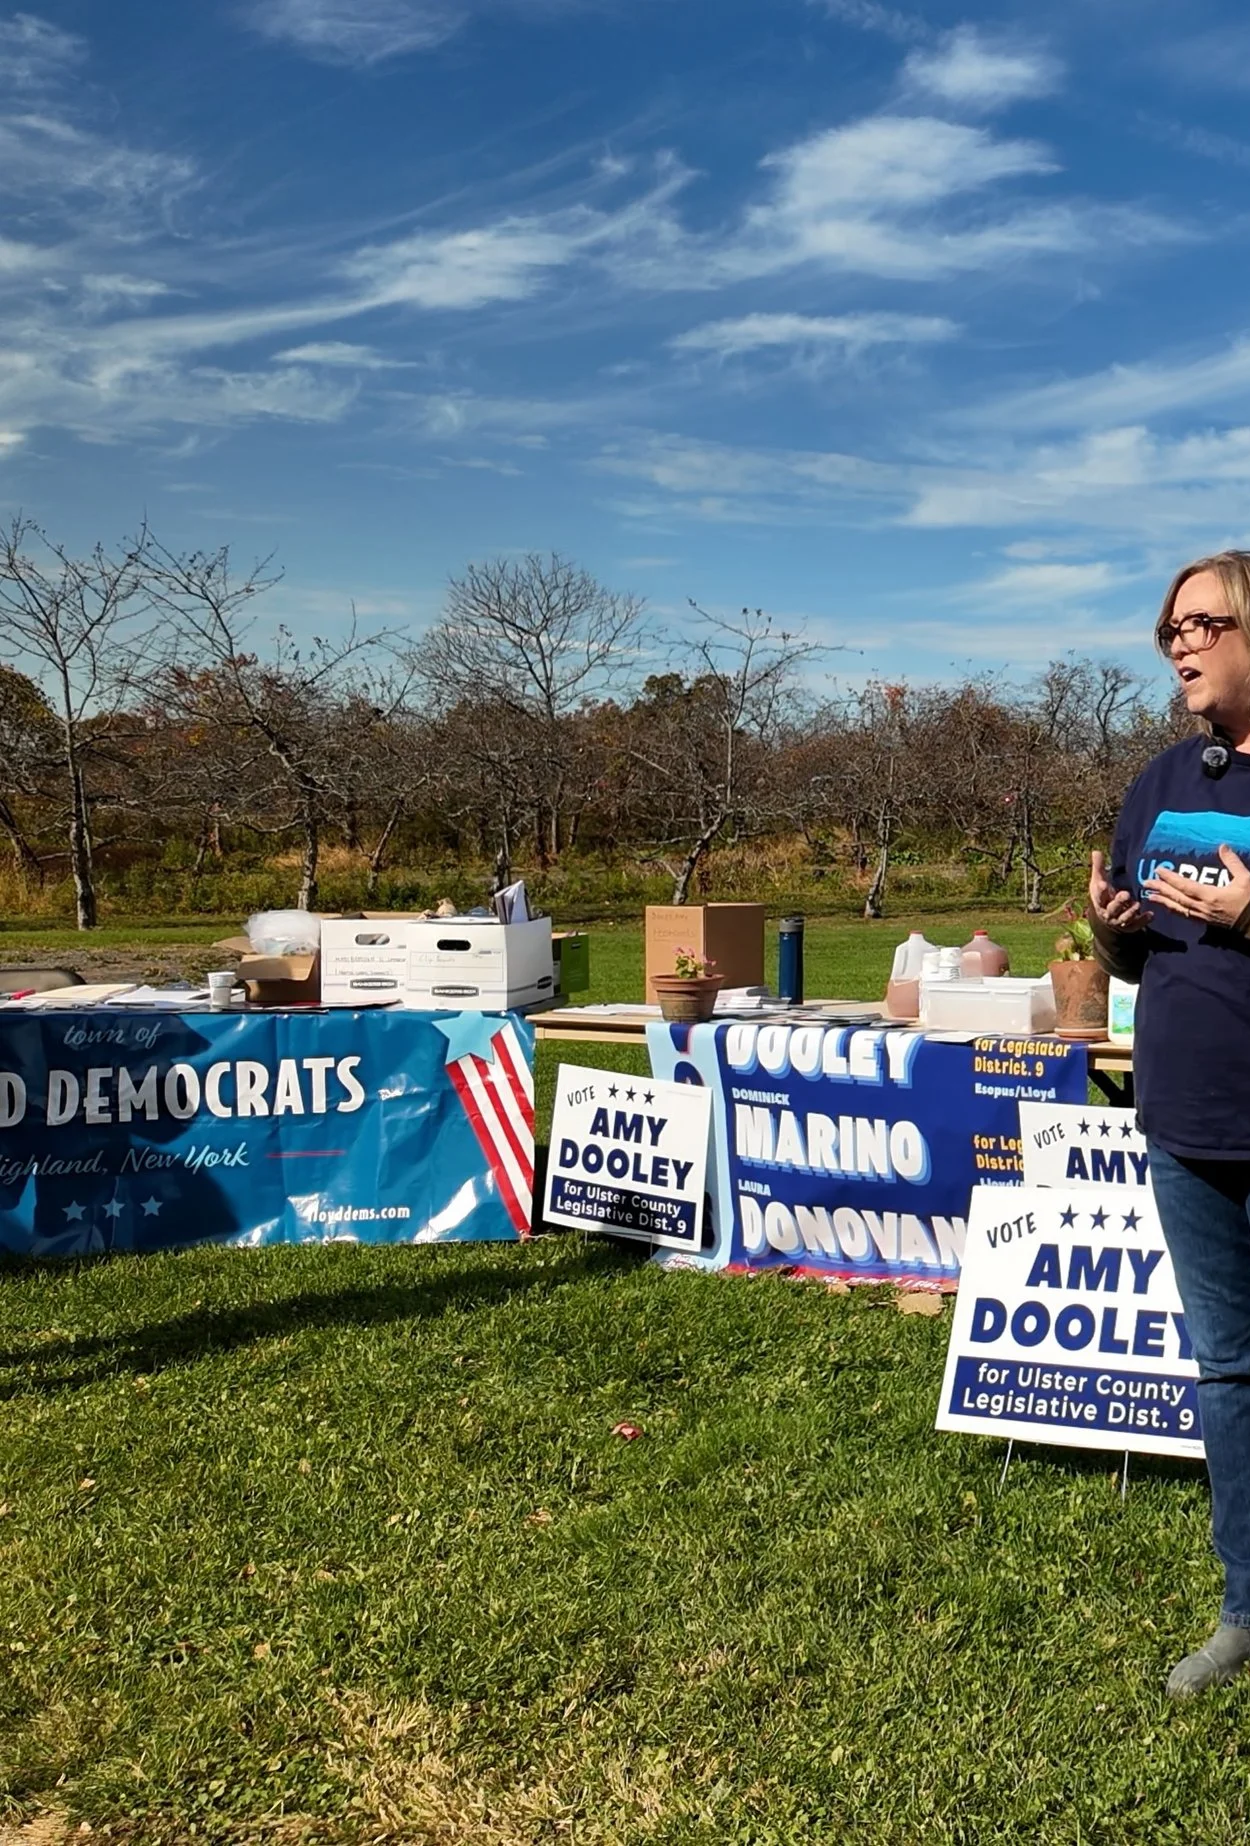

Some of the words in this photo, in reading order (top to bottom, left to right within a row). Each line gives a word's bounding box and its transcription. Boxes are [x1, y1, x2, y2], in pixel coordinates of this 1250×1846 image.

[63, 1024, 124, 1046] town
[135, 1022, 162, 1050] of
[726, 1024, 917, 1084] DOOLEY
[974, 1038, 997, 1052] for
[1000, 1039, 1071, 1058] Legislator
[974, 1056, 1031, 1076] District.
[1035, 1061, 1044, 1077] 9
[46, 1055, 365, 1127] DEMOCRATS
[567, 1085, 596, 1107] VOTE
[732, 1087, 791, 1106] DOMINICK
[974, 1083, 1056, 1101] Esopus/Lloyd
[589, 1107, 668, 1147] AMY
[735, 1103, 927, 1180] MARINO
[974, 1135, 996, 1149] for
[1033, 1122, 1066, 1149] VOTE
[0, 1150, 108, 1185] ighland,
[120, 1146, 180, 1174] New
[184, 1142, 250, 1175] York
[559, 1138, 694, 1191] DOOLEY
[1066, 1146, 1150, 1186] AMY
[564, 1181, 582, 1196] for
[586, 1187, 627, 1205] Ulster
[631, 1195, 681, 1218] County
[738, 1179, 771, 1197] LAURA
[556, 1196, 633, 1223] Legislative
[639, 1214, 672, 1232] Dist.
[677, 1220, 687, 1234] 9
[739, 1195, 967, 1267] DONOVAN
[986, 1212, 1037, 1249] VOTE
[1025, 1243, 1166, 1295] AMY
[970, 1297, 1196, 1360] DOOLEY
[978, 1363, 1010, 1385] for
[1018, 1367, 1088, 1393] Ulster
[1096, 1375, 1186, 1405] County
[962, 1387, 1098, 1421] Legislative
[1108, 1402, 1169, 1429] Dist.
[1178, 1408, 1195, 1431] 9
